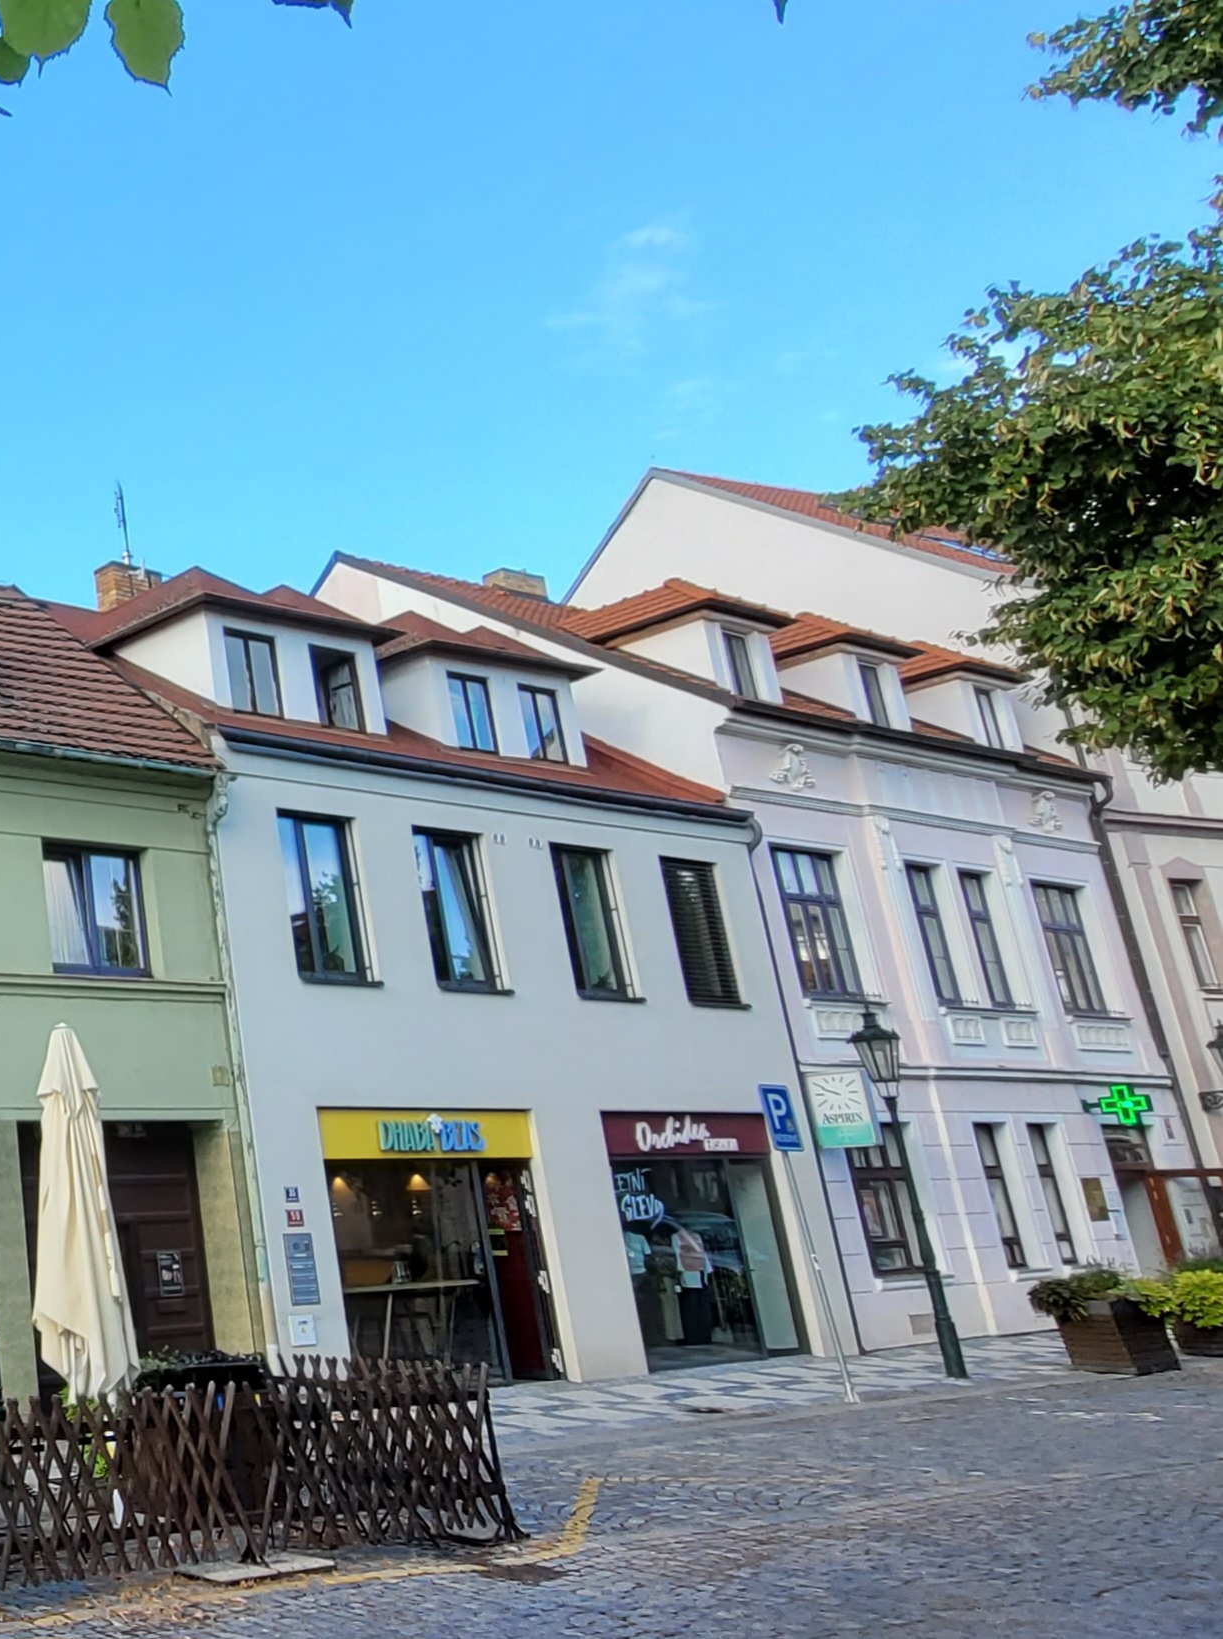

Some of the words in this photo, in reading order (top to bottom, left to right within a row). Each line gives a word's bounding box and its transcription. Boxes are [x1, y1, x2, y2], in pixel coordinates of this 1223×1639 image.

[766, 1093, 787, 1130] P
[822, 1112, 864, 1125] ASPIRIN
[377, 1119, 436, 1152] DHABA
[438, 1119, 486, 1152] BEAS
[635, 1114, 711, 1152] Orchidea
